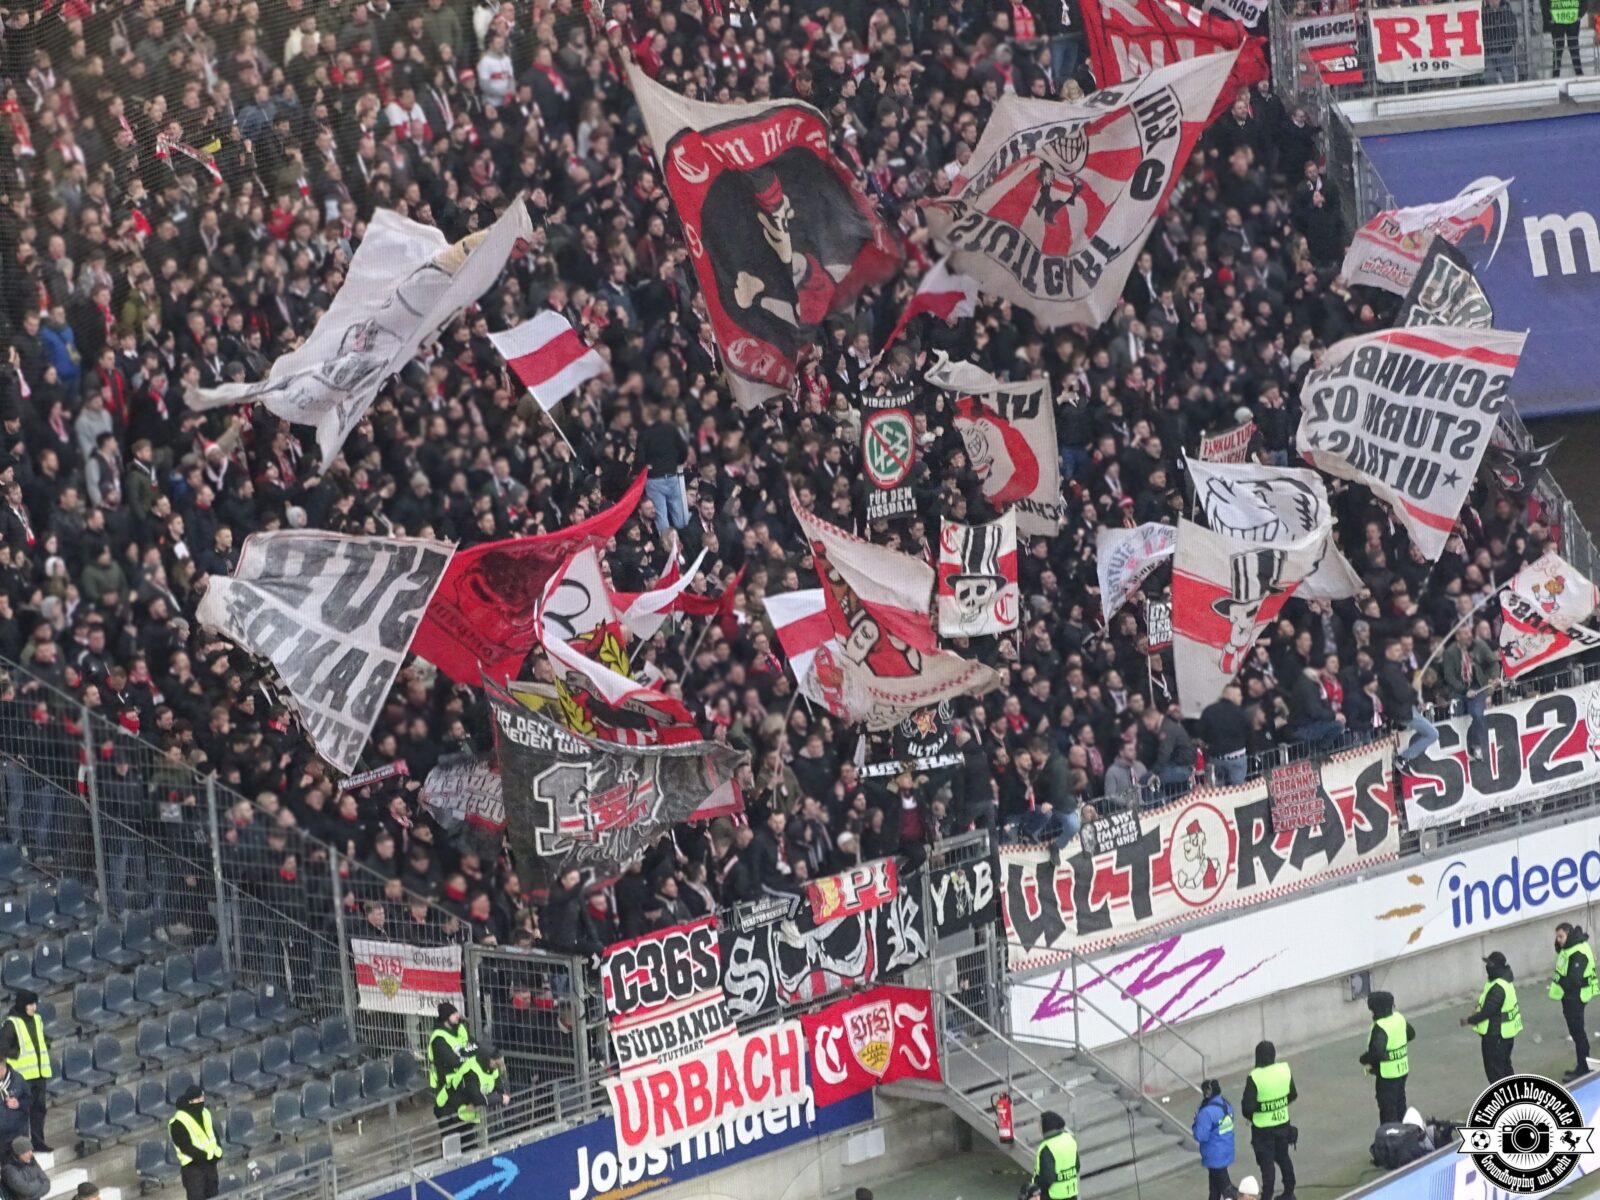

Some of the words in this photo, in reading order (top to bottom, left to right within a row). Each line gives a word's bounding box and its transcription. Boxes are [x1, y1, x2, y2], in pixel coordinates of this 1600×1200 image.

[1373, 10, 1482, 63] RH
[1096, 820, 1137, 844] IMMER
[610, 928, 720, 1014] C36S
[616, 1000, 735, 1064] SÜDBANDE
[656, 1039, 705, 1065] STUTTGART
[614, 1028, 801, 1147] URBACH
